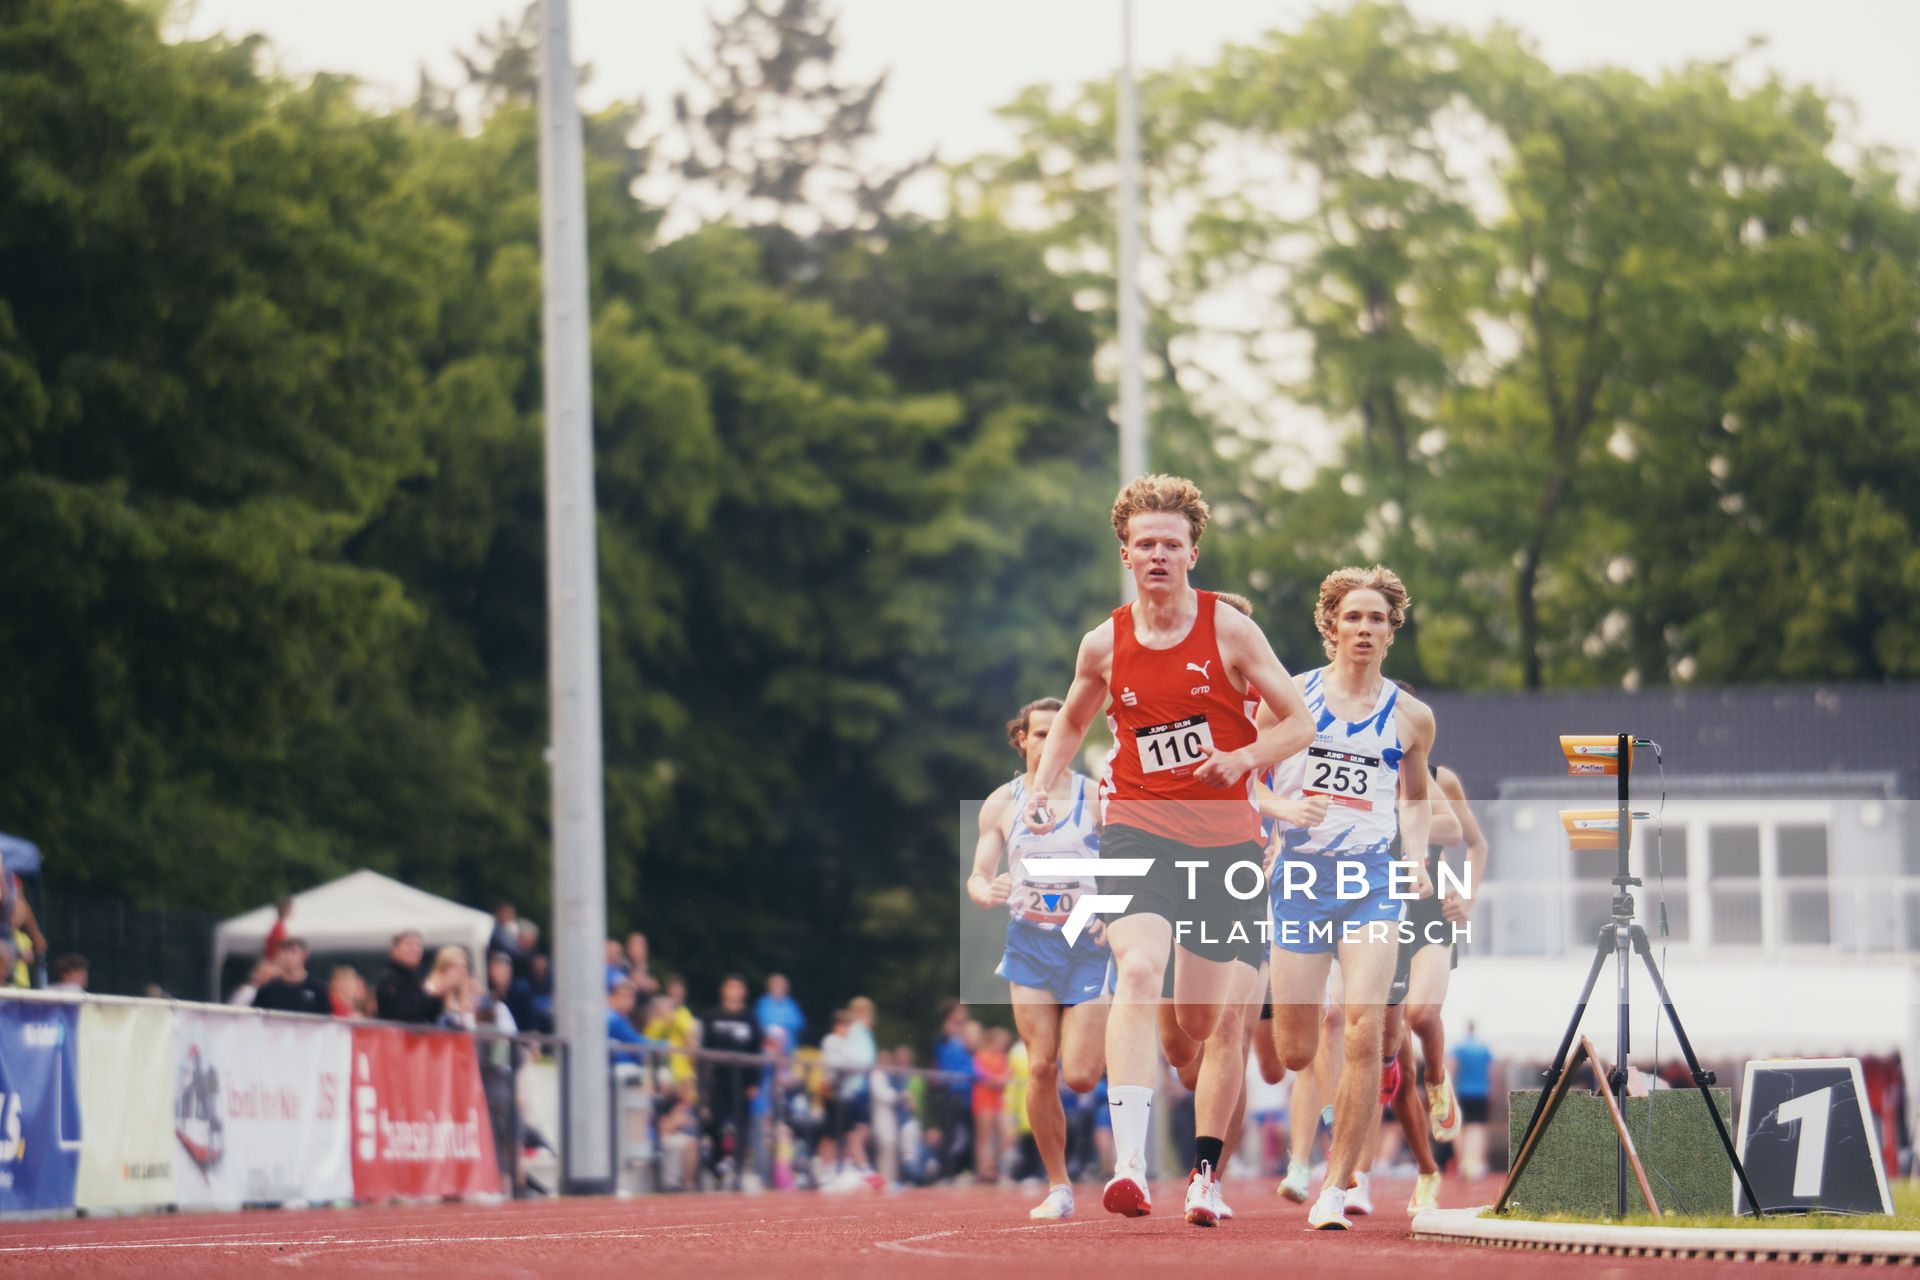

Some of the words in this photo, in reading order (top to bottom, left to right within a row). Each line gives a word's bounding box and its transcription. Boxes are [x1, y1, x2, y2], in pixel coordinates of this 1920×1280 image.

[1148, 731, 1204, 767] 110
[1312, 762, 1368, 795] 253
[1029, 891, 1073, 913] 20
[1777, 1086, 1831, 1197] 1
